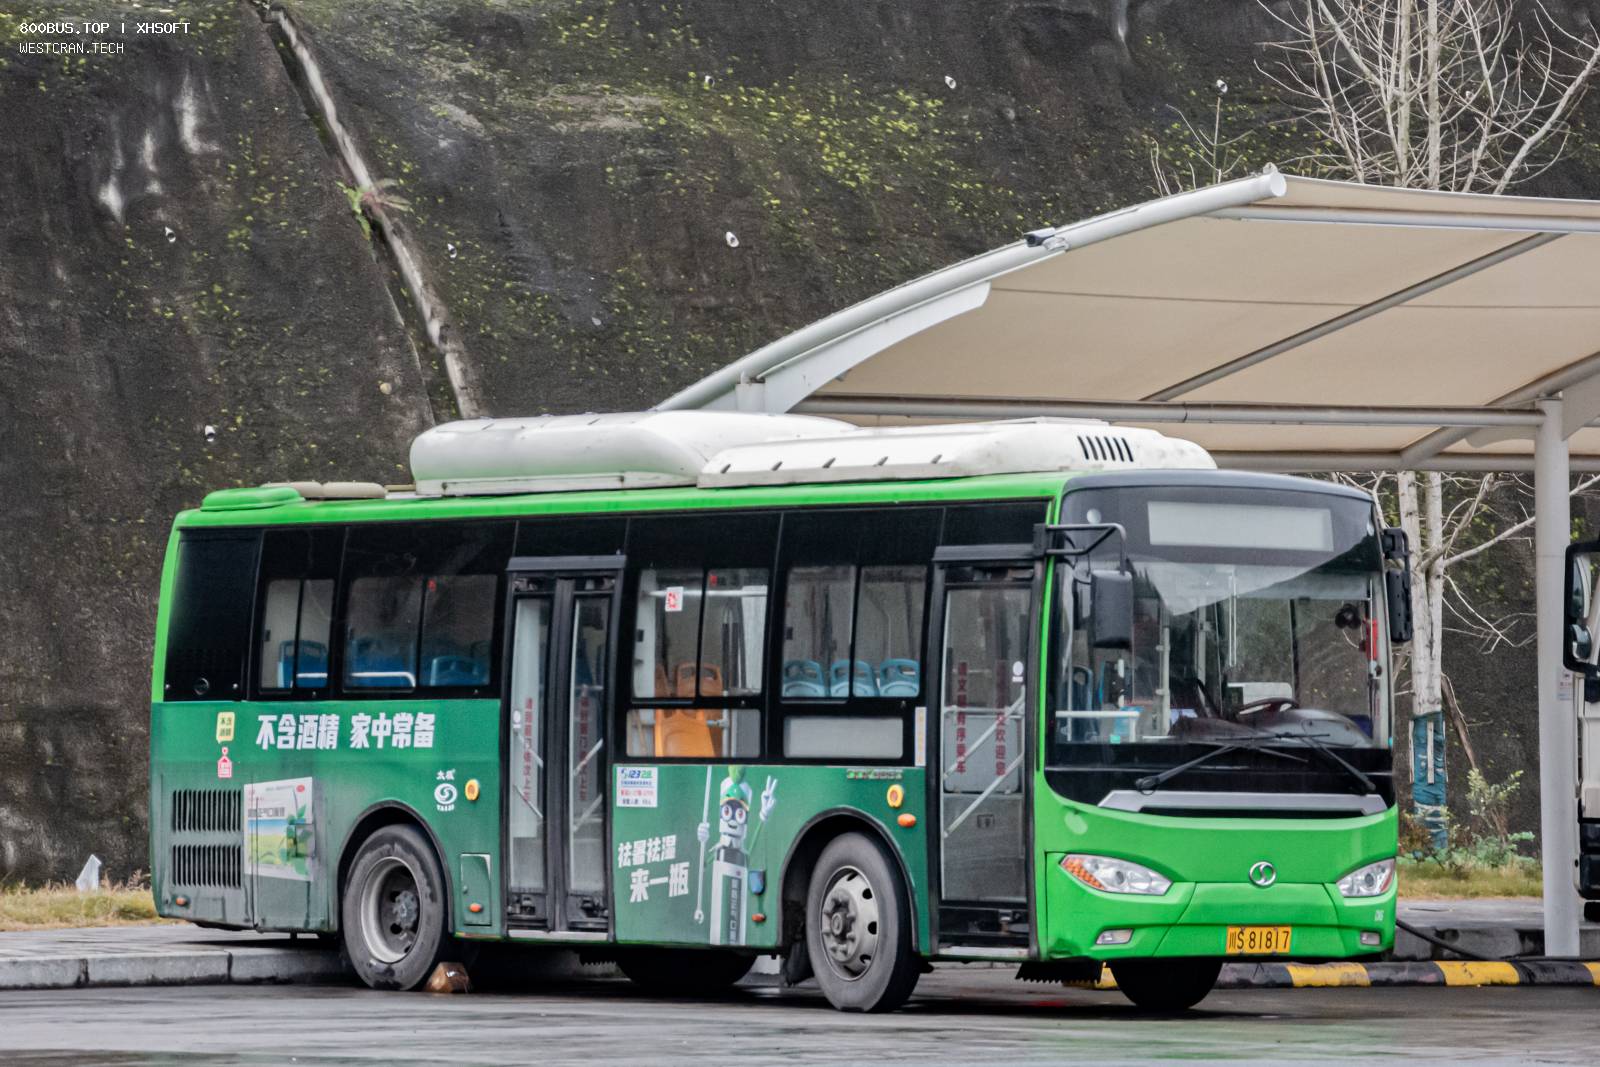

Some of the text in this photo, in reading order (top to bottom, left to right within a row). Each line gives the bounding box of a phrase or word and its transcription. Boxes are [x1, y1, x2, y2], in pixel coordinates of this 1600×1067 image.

[256, 712, 436, 750] 不含酒精 家中常备
[630, 862, 690, 903] 来一瓶
[1228, 931, 1290, 950] 川S81817
